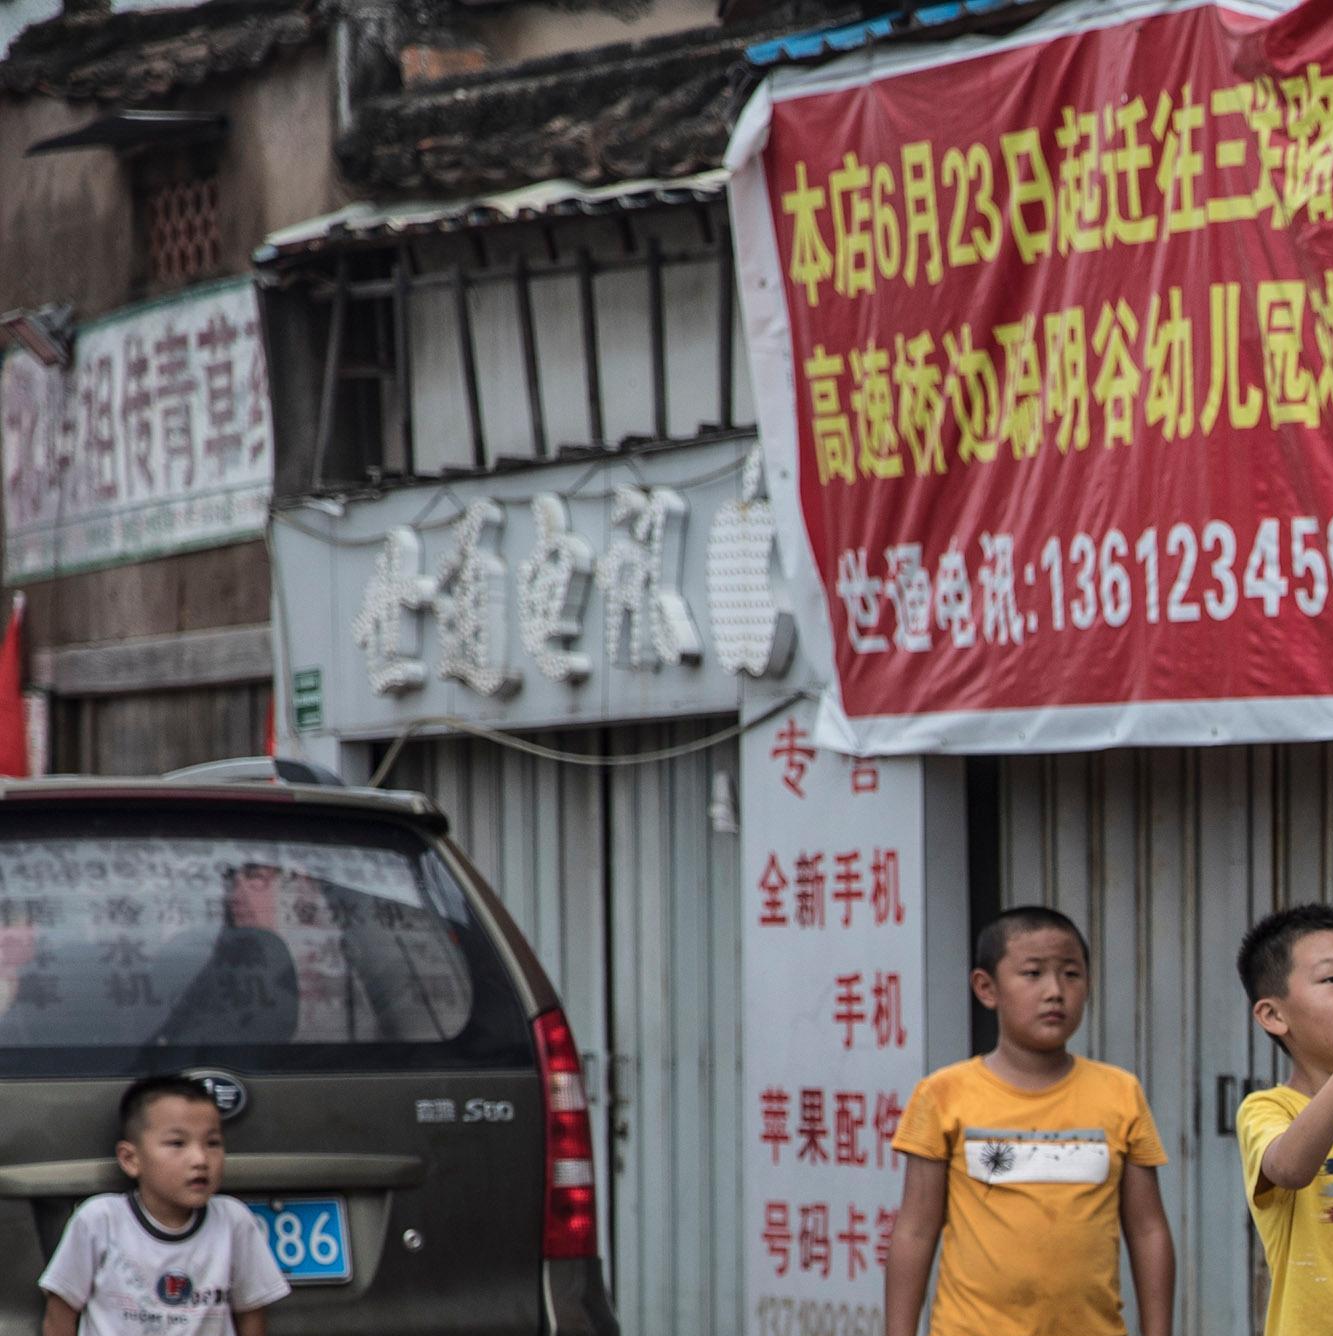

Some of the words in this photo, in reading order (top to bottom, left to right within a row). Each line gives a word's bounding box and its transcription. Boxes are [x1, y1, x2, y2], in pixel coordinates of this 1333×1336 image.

[759, 848, 905, 930] 全新手机
[834, 971, 907, 1050] 手机
[759, 1085, 904, 1170] 苹果配件
[254, 1211, 339, 1267] 86
